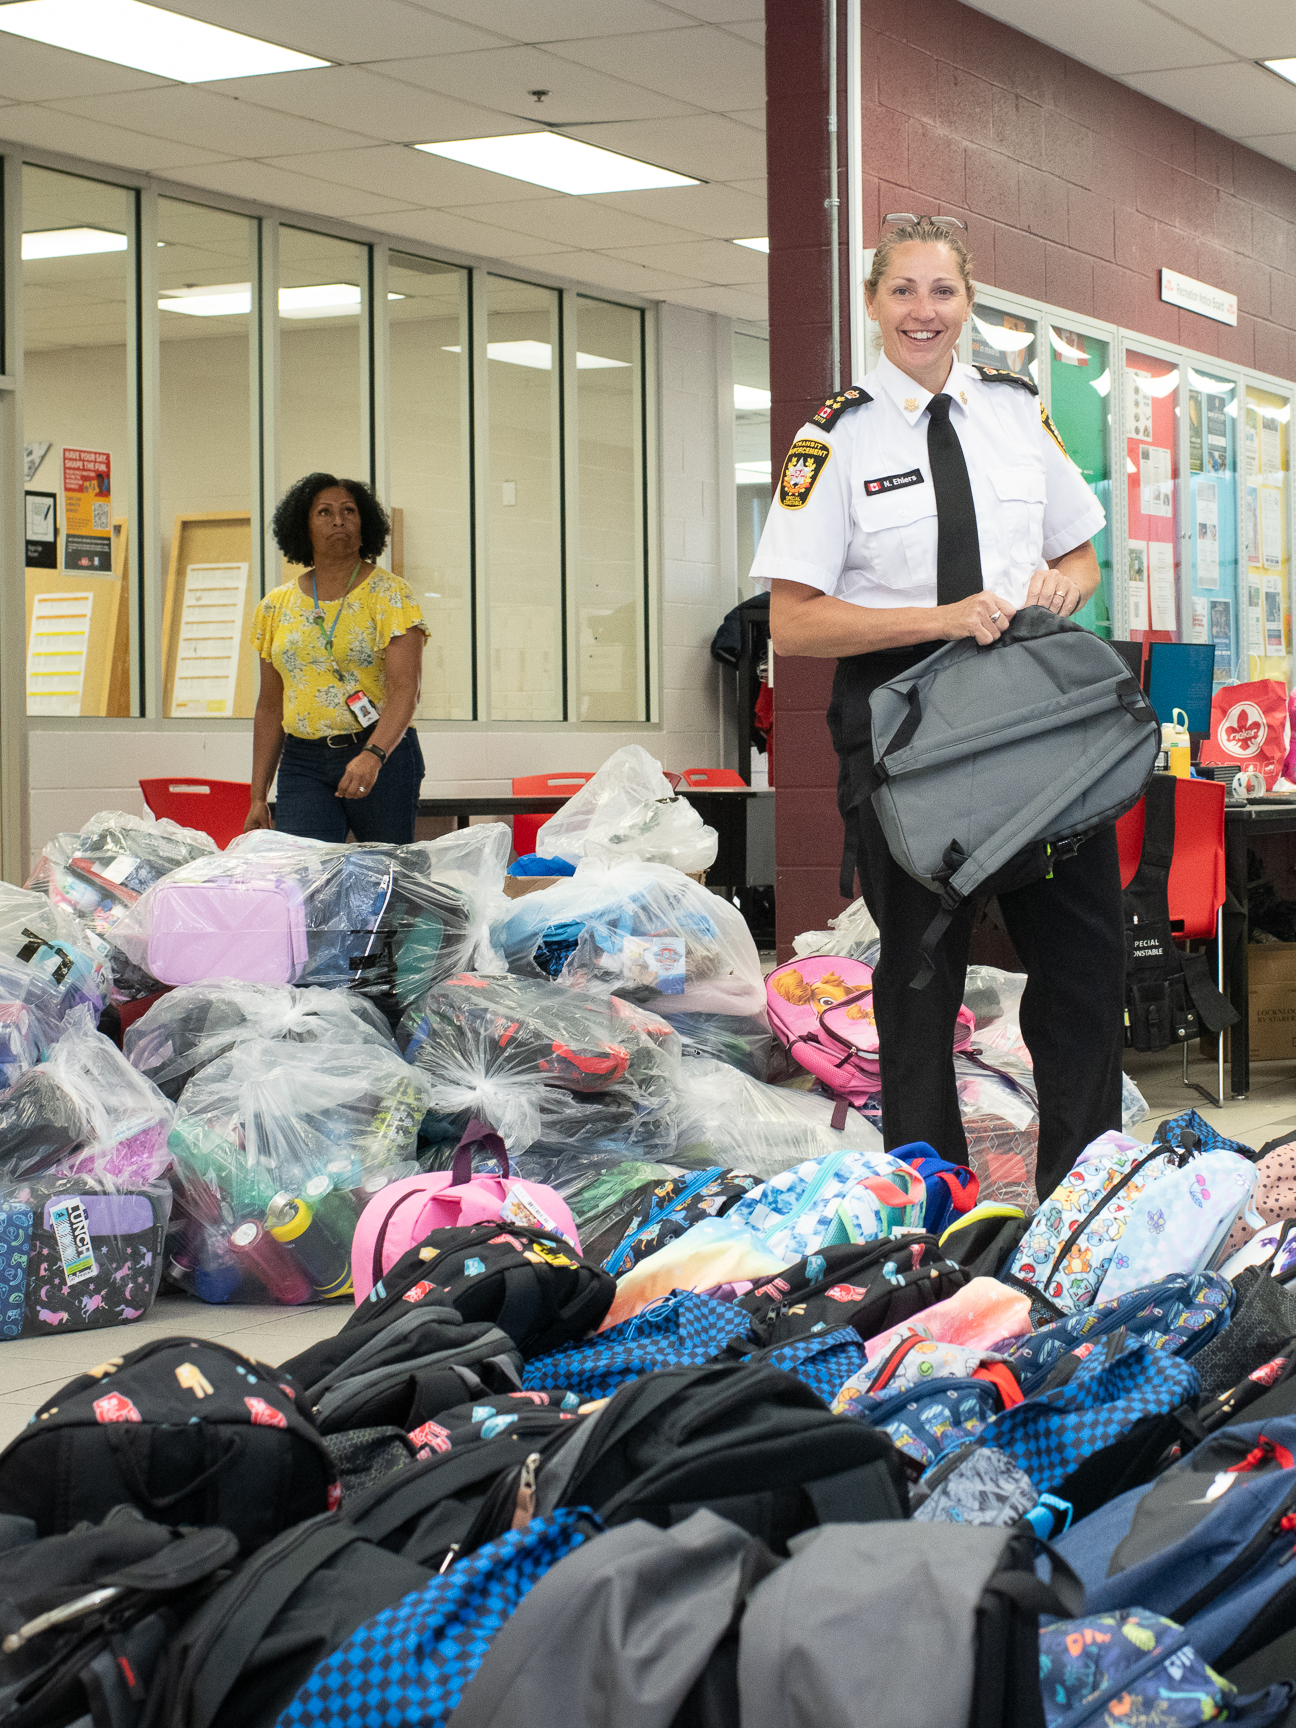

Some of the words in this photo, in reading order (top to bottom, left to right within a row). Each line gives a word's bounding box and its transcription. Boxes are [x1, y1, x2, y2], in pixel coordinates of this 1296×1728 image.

[1176, 283, 1198, 302] Recreation
[1199, 293, 1212, 307] Notice
[1212, 297, 1225, 312] Board
[65, 450, 80, 460] HAVE
[81, 452, 96, 461] YOUR
[65, 459, 84, 469] SHAPE
[84, 461, 95, 470] THE
[883, 480, 893, 488] N.
[892, 475, 918, 486] Ehlers
[1134, 938, 1160, 948] PECIAL
[1133, 947, 1164, 958] ONSTABLE
[67, 1204, 91, 1259] LUNCH
